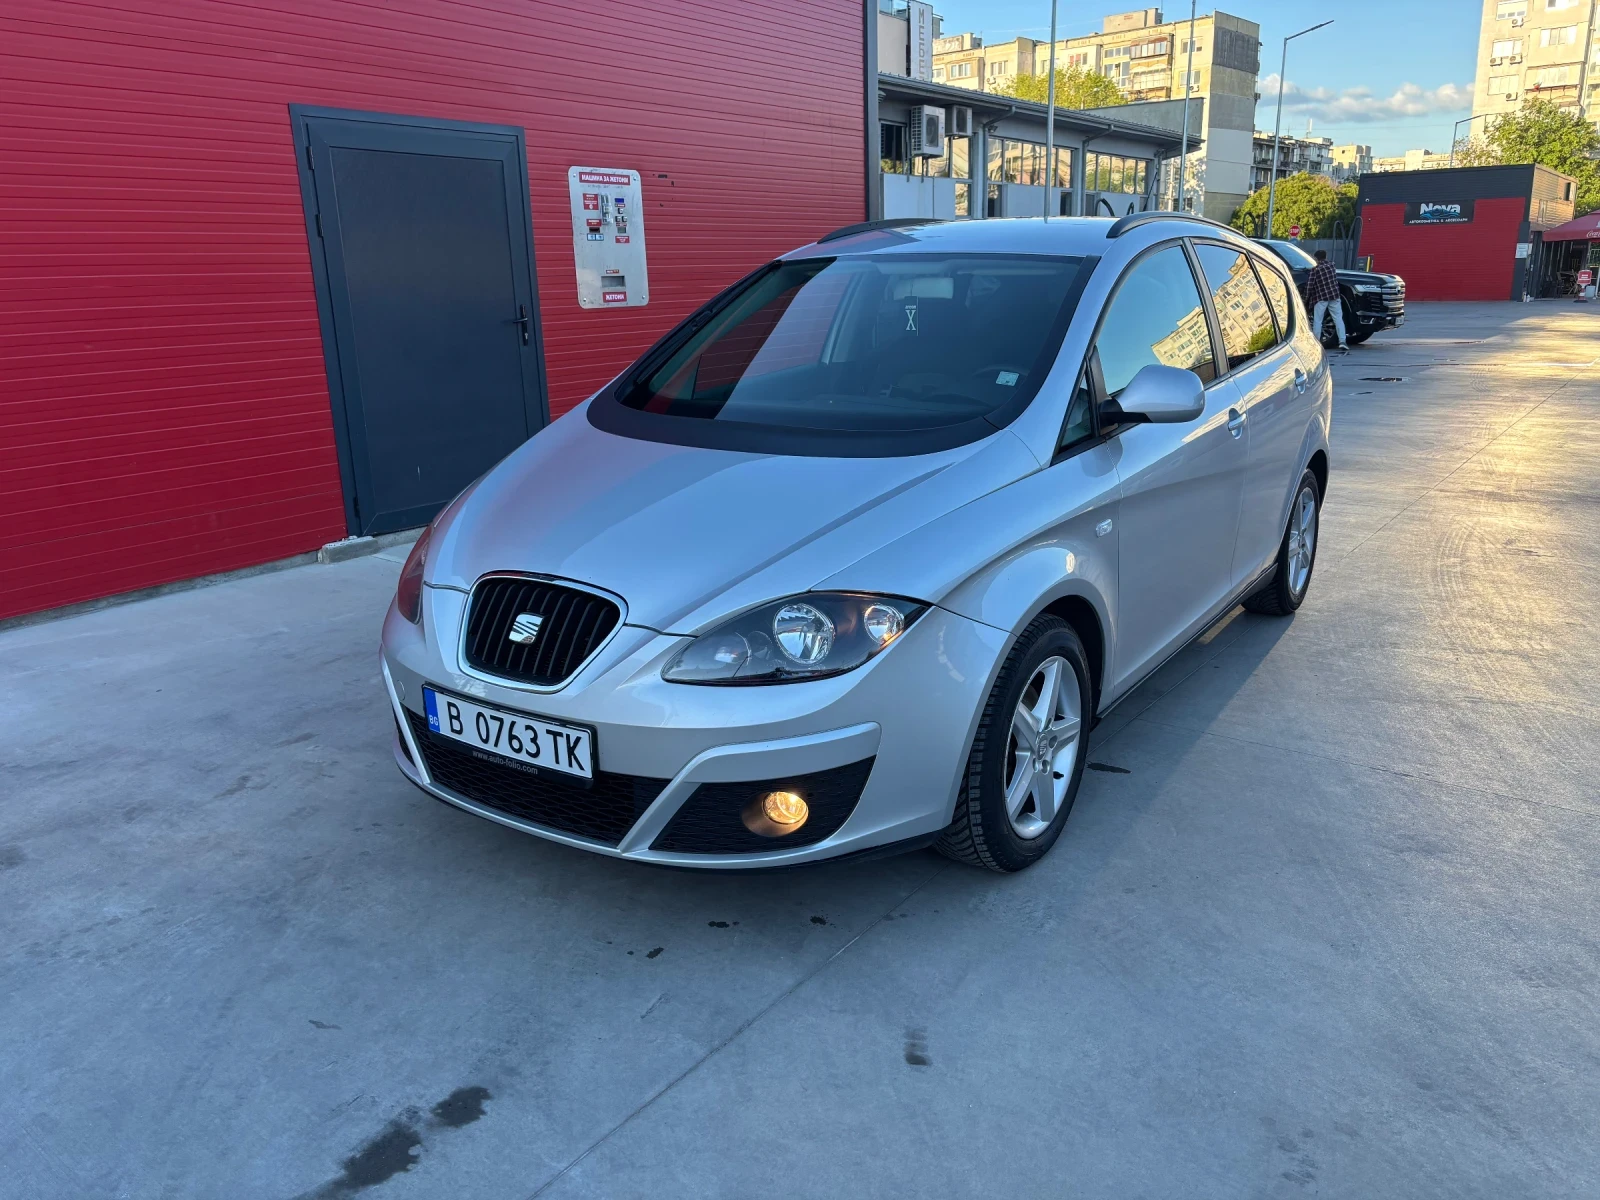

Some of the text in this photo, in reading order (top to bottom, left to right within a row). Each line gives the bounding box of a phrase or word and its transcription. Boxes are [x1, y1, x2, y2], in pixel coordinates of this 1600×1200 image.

[581, 174, 603, 182] МАШИНА
[610, 176, 629, 184] ЖЕТОНИ
[1420, 203, 1460, 214] Nova
[428, 714, 439, 726] BG
[447, 700, 586, 771] B 0763 TK
[472, 750, 539, 775] www.auto-folio.com
